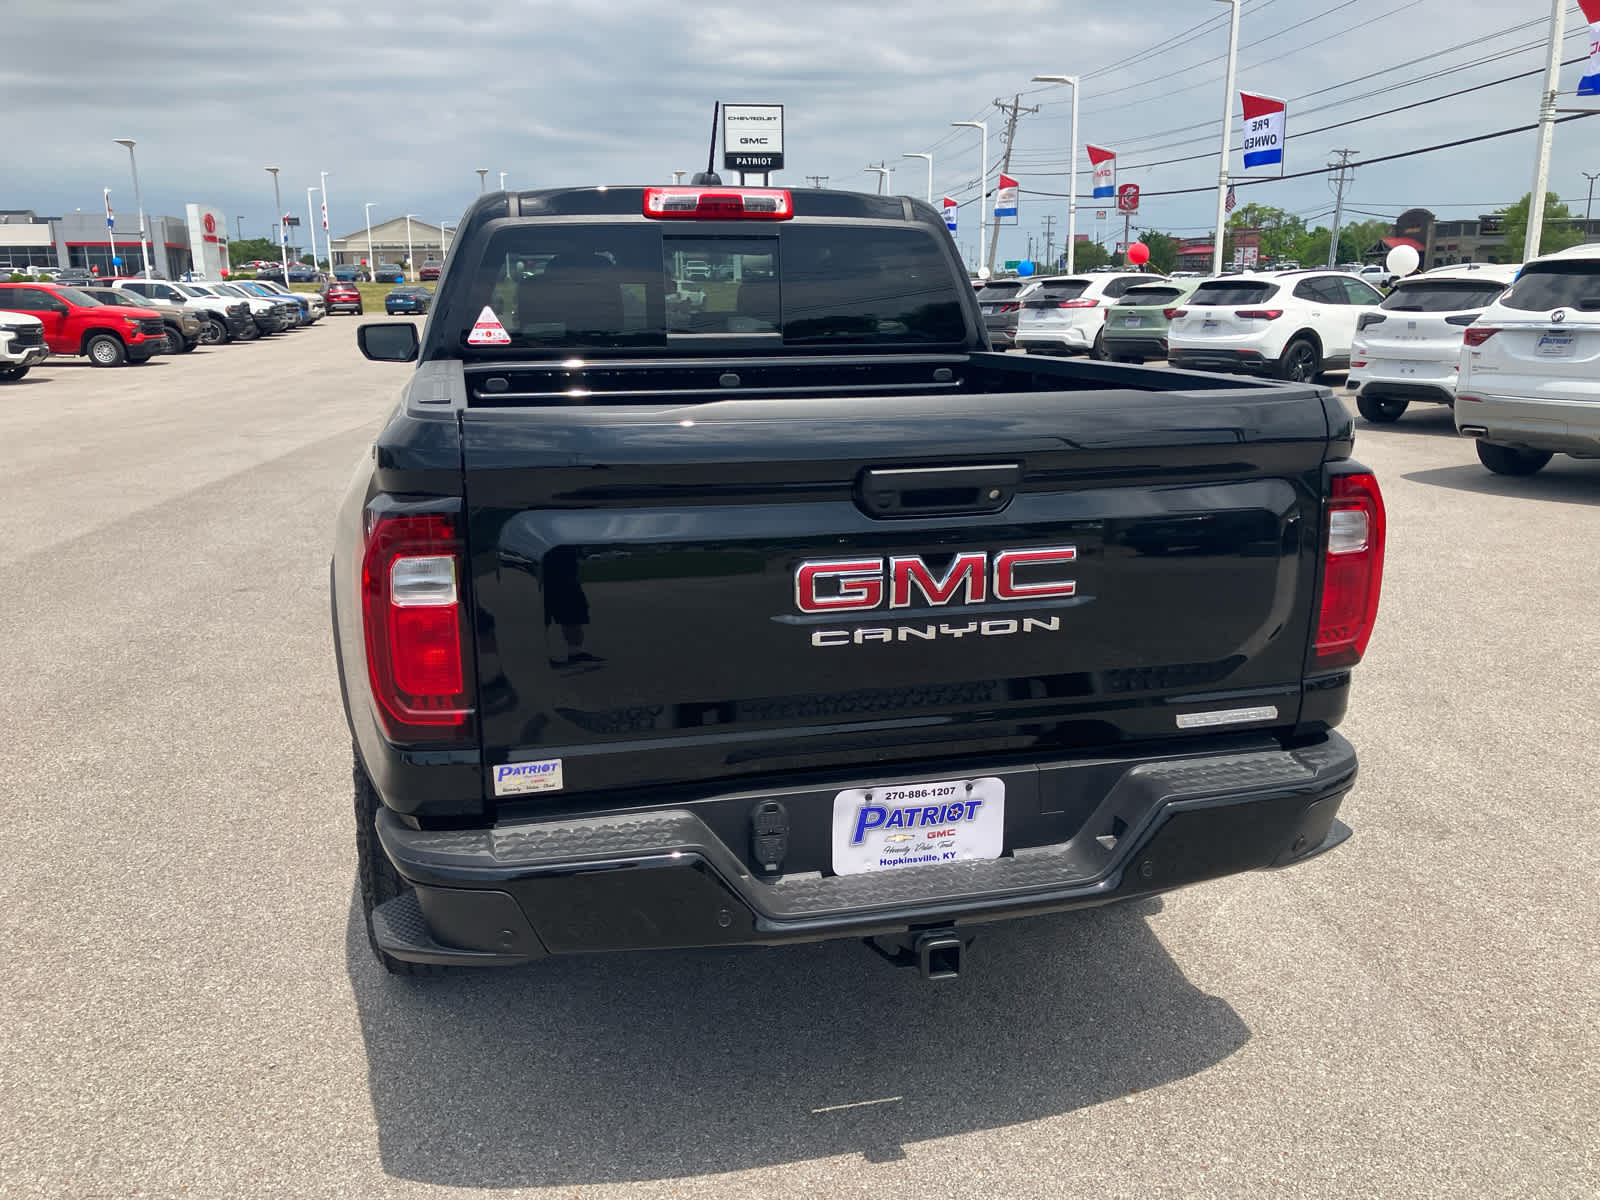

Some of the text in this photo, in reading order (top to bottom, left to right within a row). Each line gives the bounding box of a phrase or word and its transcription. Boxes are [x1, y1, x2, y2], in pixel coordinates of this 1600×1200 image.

[736, 157, 772, 165] PATRIOT
[795, 546, 1077, 613] GMC
[811, 616, 1060, 646] CANYON
[498, 763, 558, 782] PATRIOT
[885, 787, 956, 800] 270-886-1207
[852, 800, 982, 844] PATRIOT
[927, 829, 956, 839] GMC
[880, 851, 957, 866] Hopkinsville, KY
